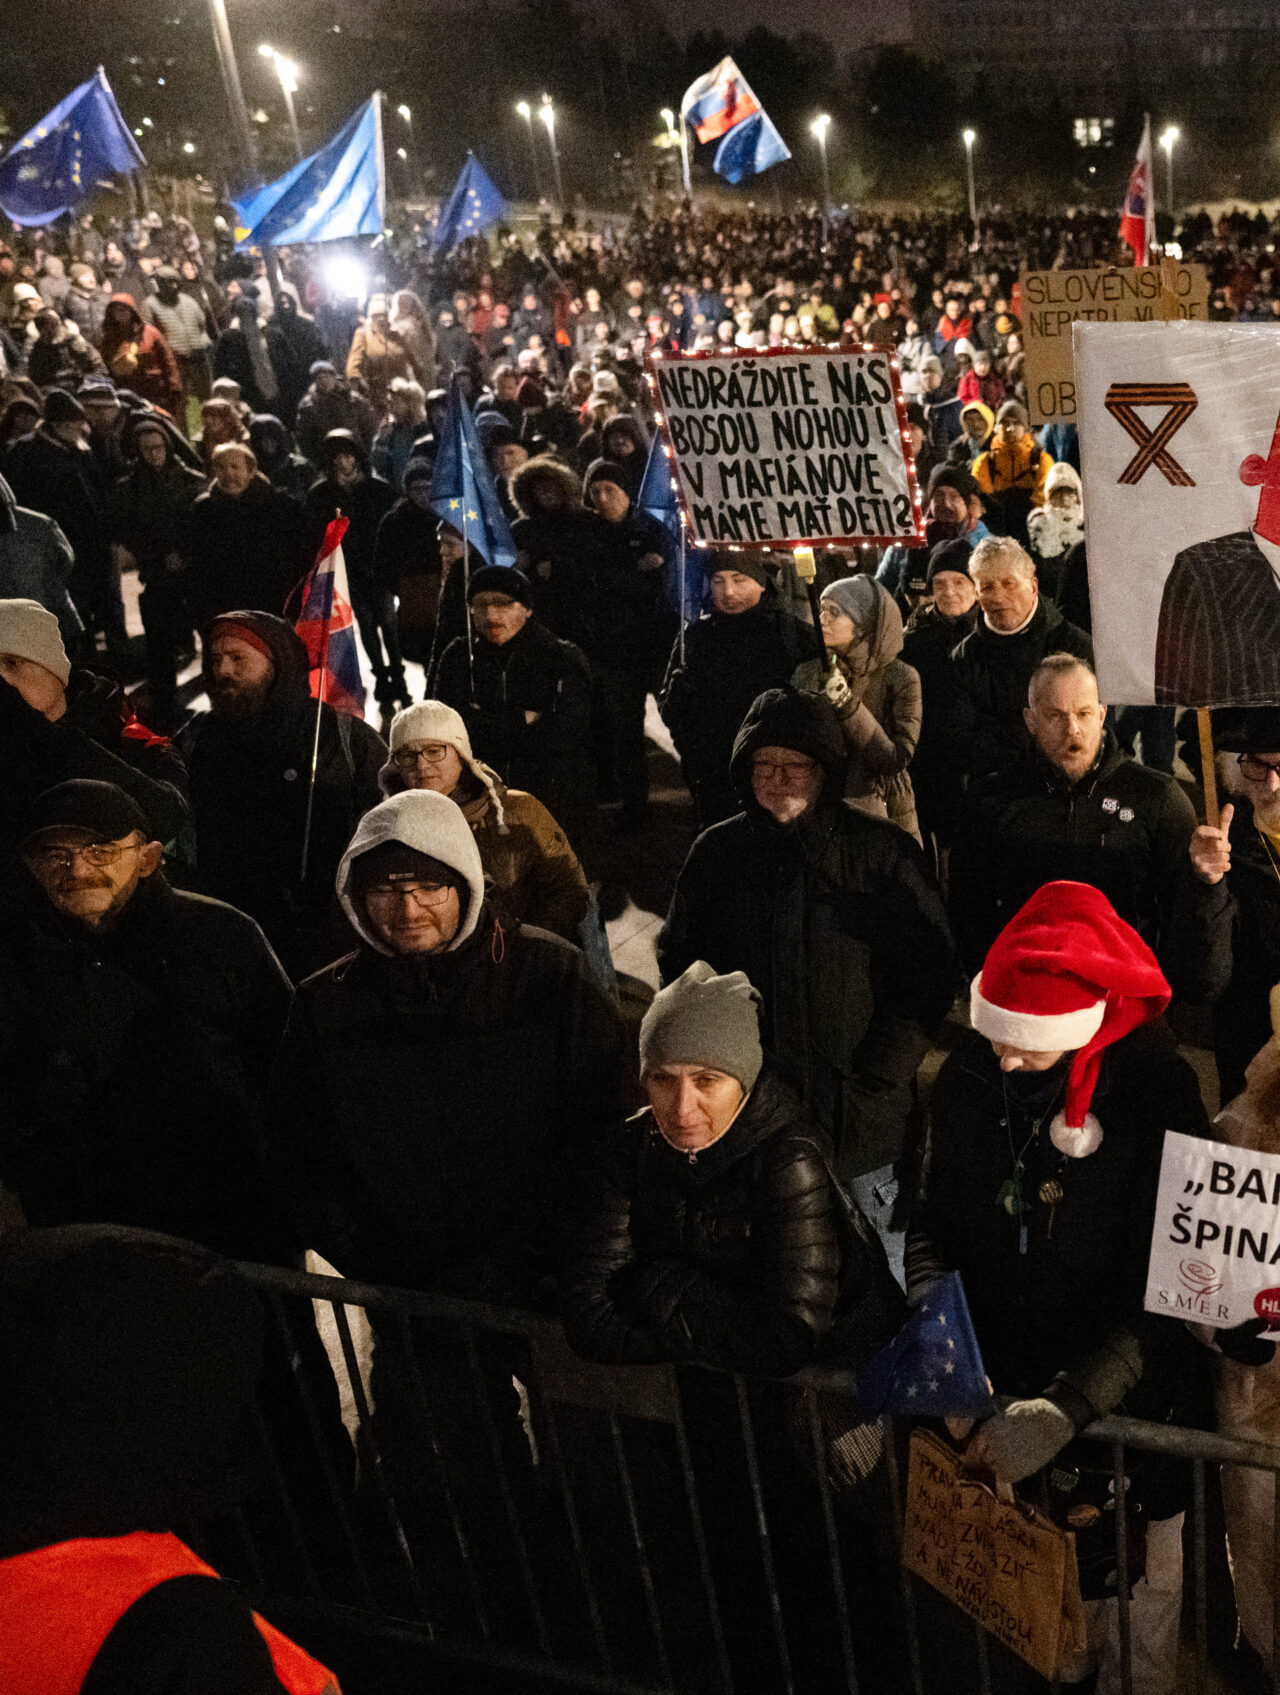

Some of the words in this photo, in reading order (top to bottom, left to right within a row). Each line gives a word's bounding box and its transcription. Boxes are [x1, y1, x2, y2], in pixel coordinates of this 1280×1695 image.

[1025, 269, 1192, 304] SLOVENSO
[657, 360, 819, 409] NEDRÁŽDITE
[827, 357, 892, 406] NÁS
[669, 412, 760, 456] BOSOU
[681, 461, 703, 498] V
[718, 452, 884, 500] MAFIÁNOVE
[691, 500, 773, 541] MÁME
[777, 496, 832, 538] MAŤ
[1158, 1290, 1229, 1320] SMER
